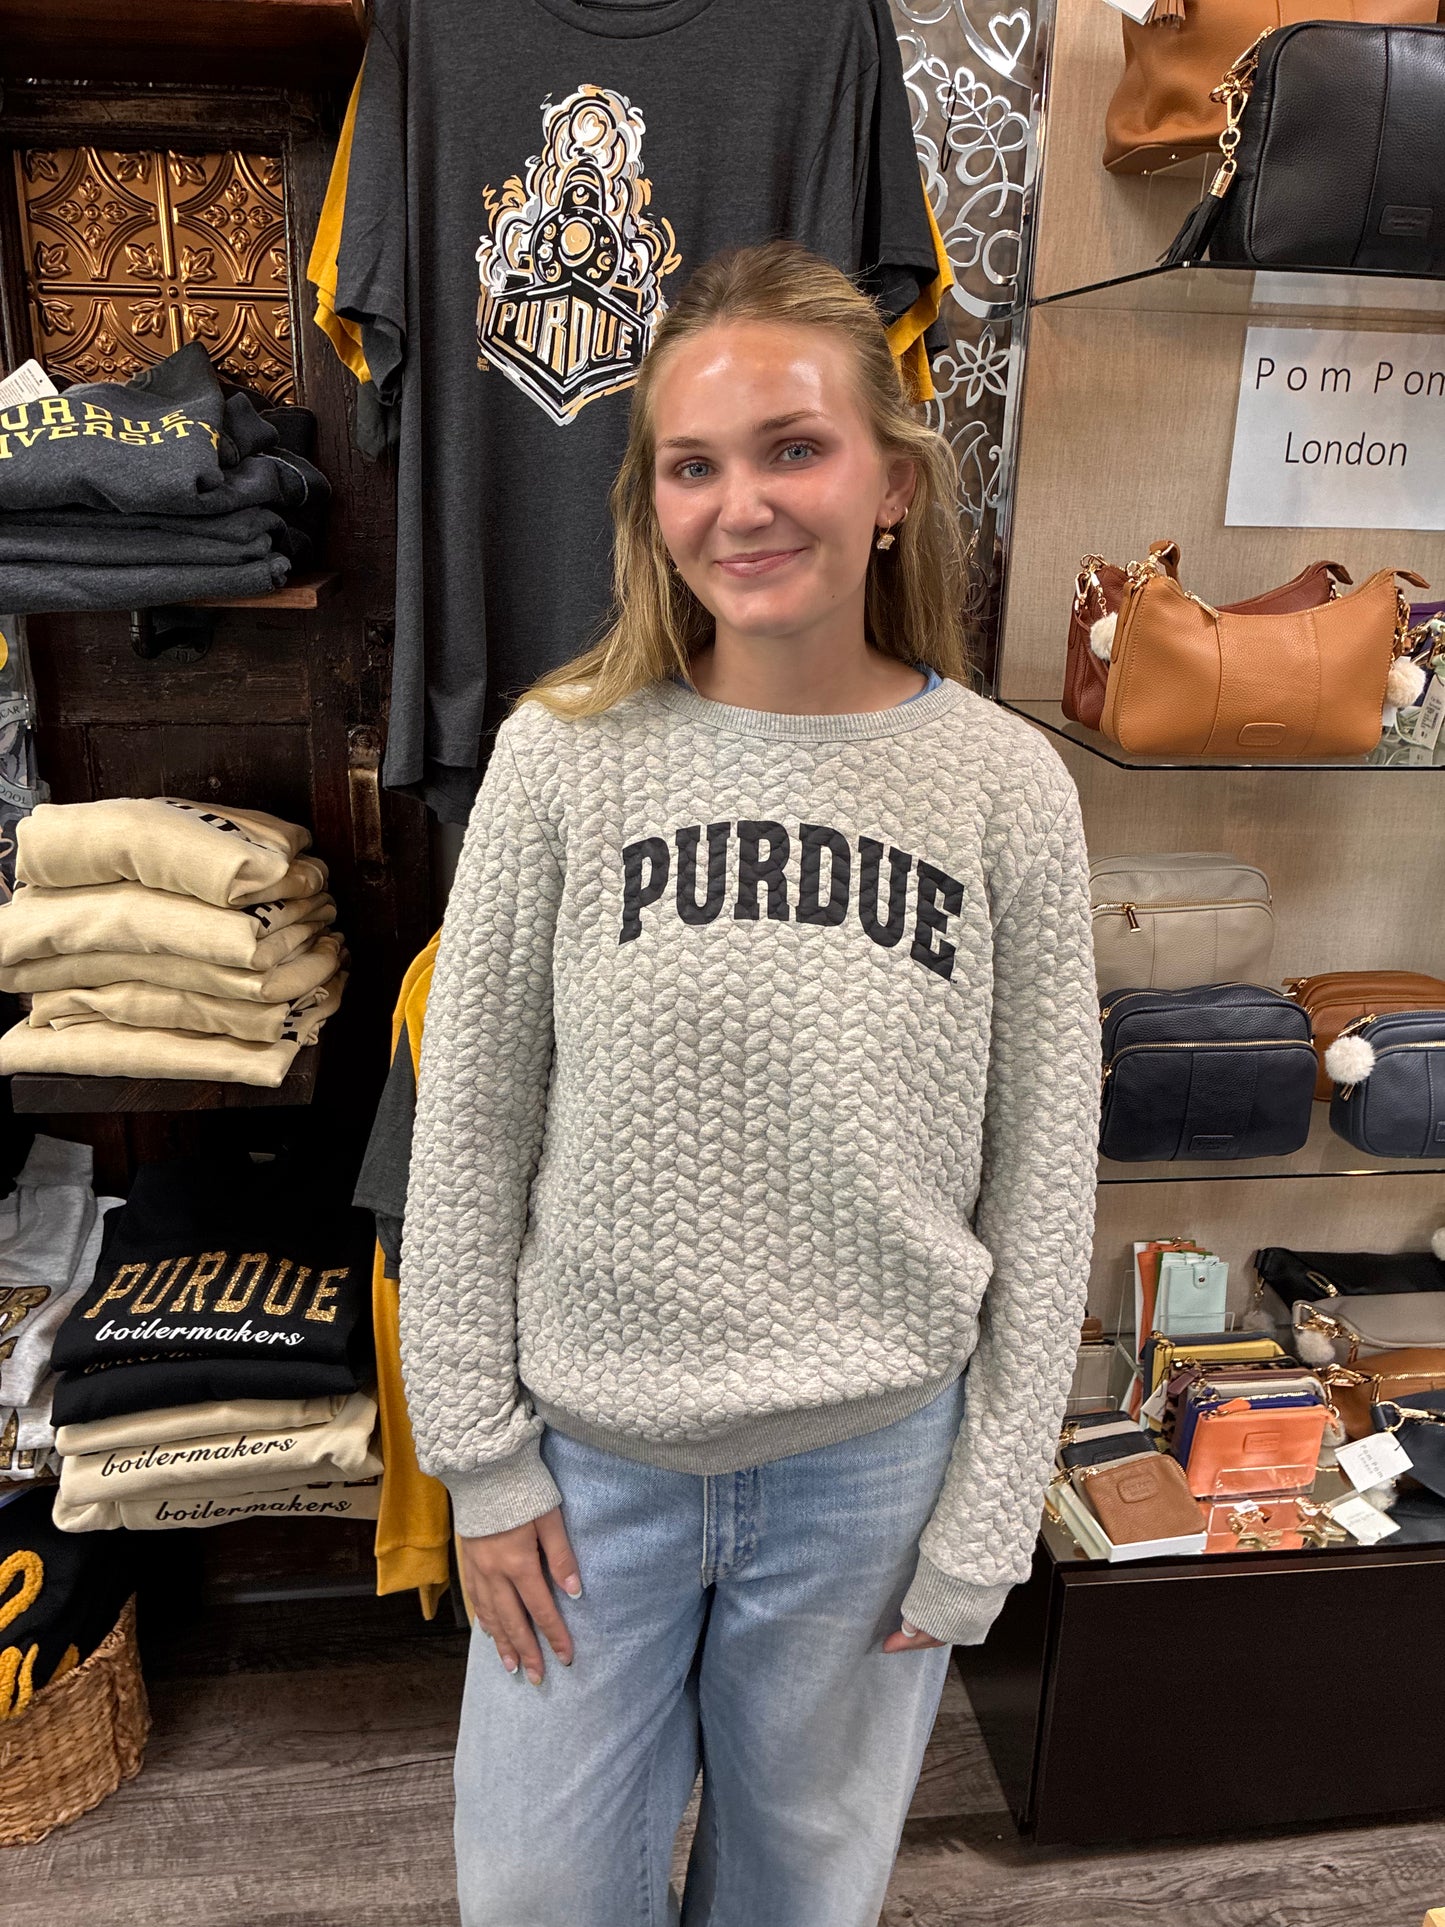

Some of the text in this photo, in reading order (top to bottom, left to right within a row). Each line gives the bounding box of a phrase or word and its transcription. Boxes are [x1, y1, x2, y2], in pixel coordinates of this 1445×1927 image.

[497, 295, 633, 377] PURDUE
[1255, 357, 1351, 393] Pom
[1285, 431, 1408, 467] London
[618, 820, 965, 982] PURDUE
[83, 1251, 350, 1323] PURDUE
[95, 1318, 305, 1346] boilermakers
[100, 1435, 297, 1477] boilermakers
[155, 1494, 352, 1522] boilermakers
